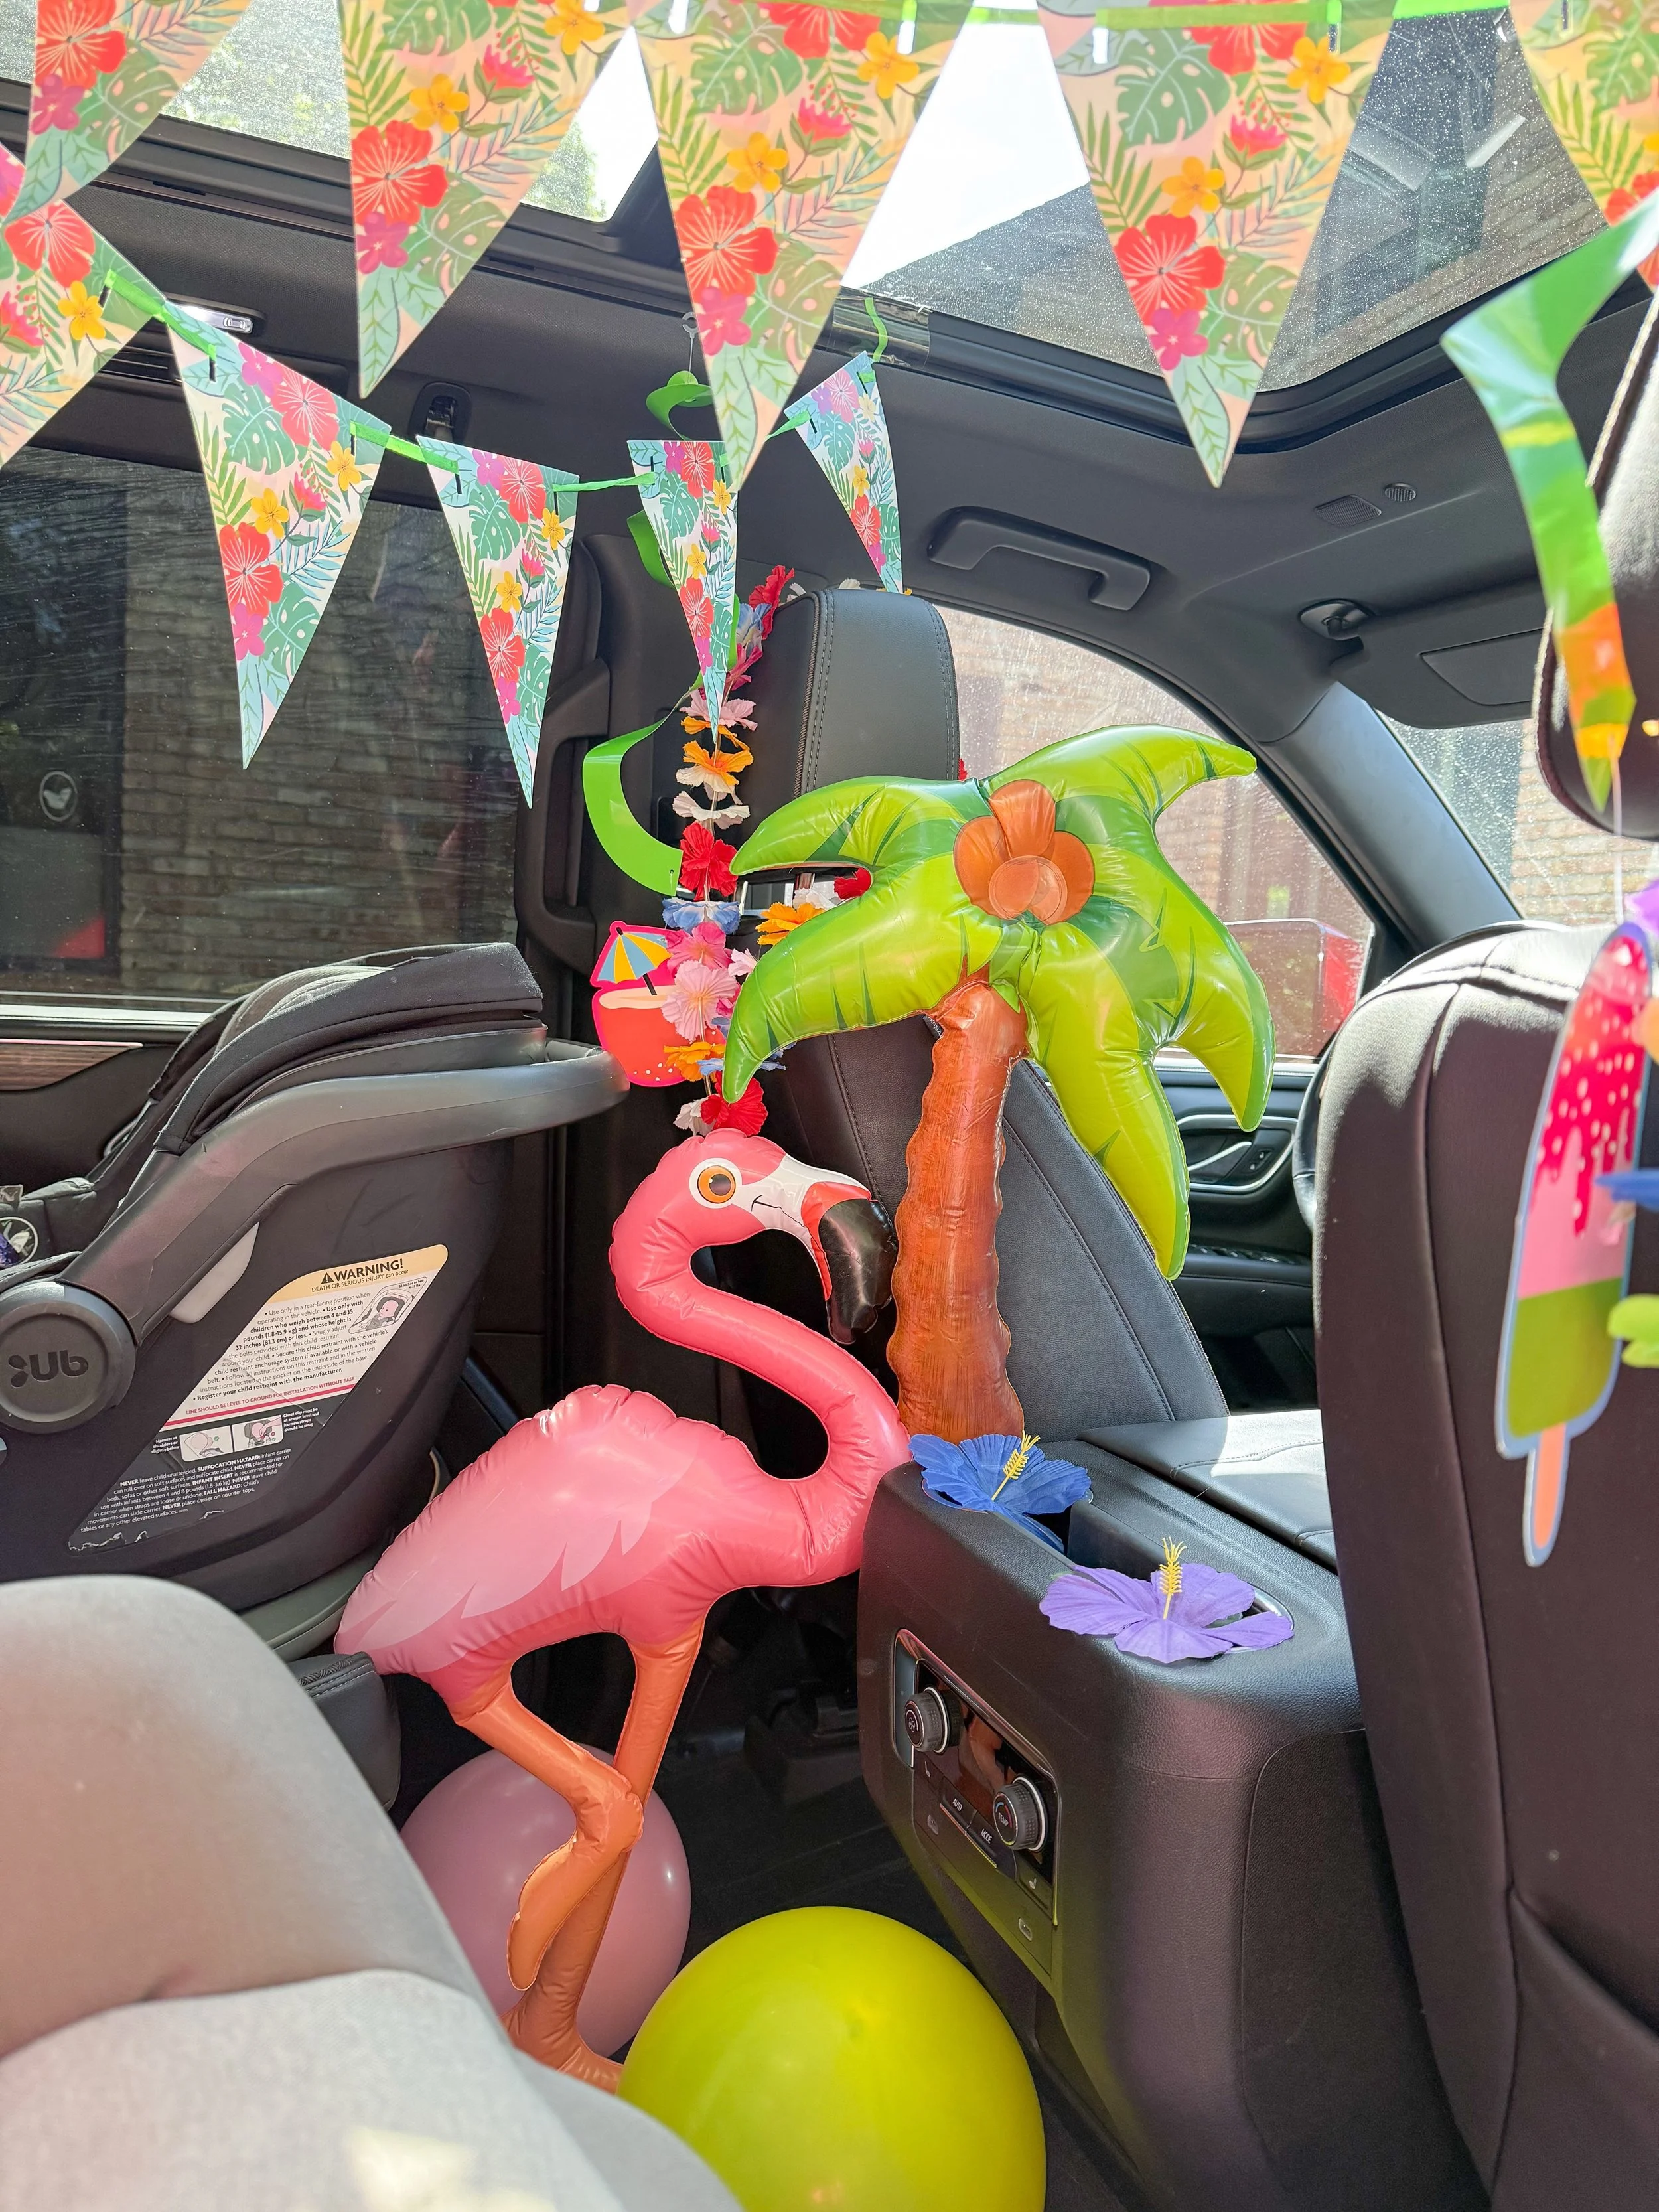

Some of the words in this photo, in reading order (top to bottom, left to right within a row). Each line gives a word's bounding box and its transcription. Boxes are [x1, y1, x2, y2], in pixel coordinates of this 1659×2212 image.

[334, 1258, 403, 1282] WARNING!
[311, 1284, 330, 1293] DEATH
[341, 1278, 365, 1287] SERIOUS
[365, 1274, 384, 1282] INJURY
[304, 1299, 333, 1309] rear-facing
[333, 1295, 355, 1305] position
[243, 1333, 265, 1344] pounds
[265, 1329, 287, 1339] (1.8-15.9
[328, 1317, 346, 1326] height
[257, 1316, 284, 1326] operating
[288, 1318, 305, 1327] weigh
[306, 1315, 330, 1323] between
[253, 1344, 279, 1356] provided
[318, 1333, 340, 1342] restraint
[262, 1338, 275, 1347] (81.3
[321, 1339, 343, 1348] restraint
[366, 1329, 388, 1339] vehicle's
[254, 1359, 283, 1369] anchorage
[309, 1348, 333, 1357] available
[358, 1339, 377, 1347] vehicle
[253, 1364, 286, 1376] instructions
[306, 1357, 328, 1365] restraint
[197, 1392, 222, 1401] Register
[222, 1389, 237, 1398] your
[303, 1368, 342, 1380] manufacturer.
[200, 1382, 234, 1393] instructions
[273, 1371, 292, 1380] pocket
[311, 1361, 338, 1371] underside
[198, 1404, 220, 1413] SHOULD
[250, 1394, 273, 1402] GROUND
[283, 1385, 319, 1396] INSTALLATION
[318, 1379, 343, 1388] WITHOUT
[952, 1799, 962, 1812] AUTO
[999, 1812, 1009, 1826] TEMP
[980, 1828, 993, 1844] MODE
